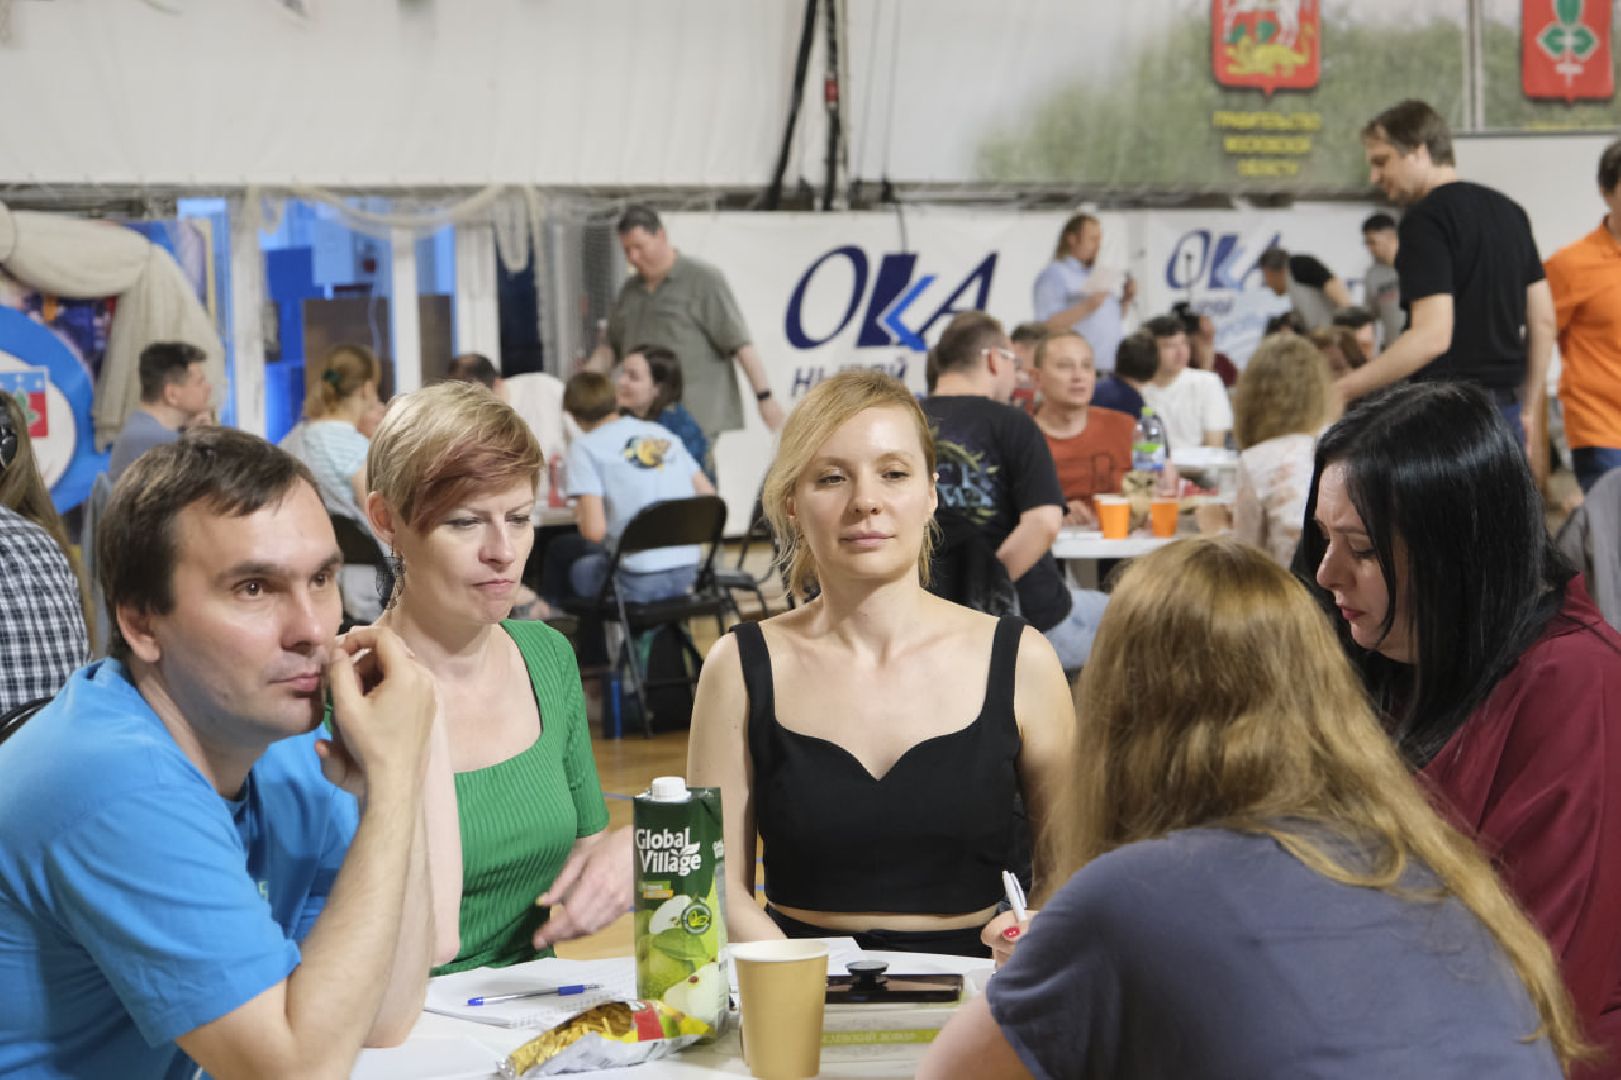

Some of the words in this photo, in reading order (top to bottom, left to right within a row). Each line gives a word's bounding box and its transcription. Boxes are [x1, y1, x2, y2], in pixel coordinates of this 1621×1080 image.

[784, 244, 1000, 352] ОКА
[636, 827, 692, 850] Global
[639, 850, 702, 877] Village
